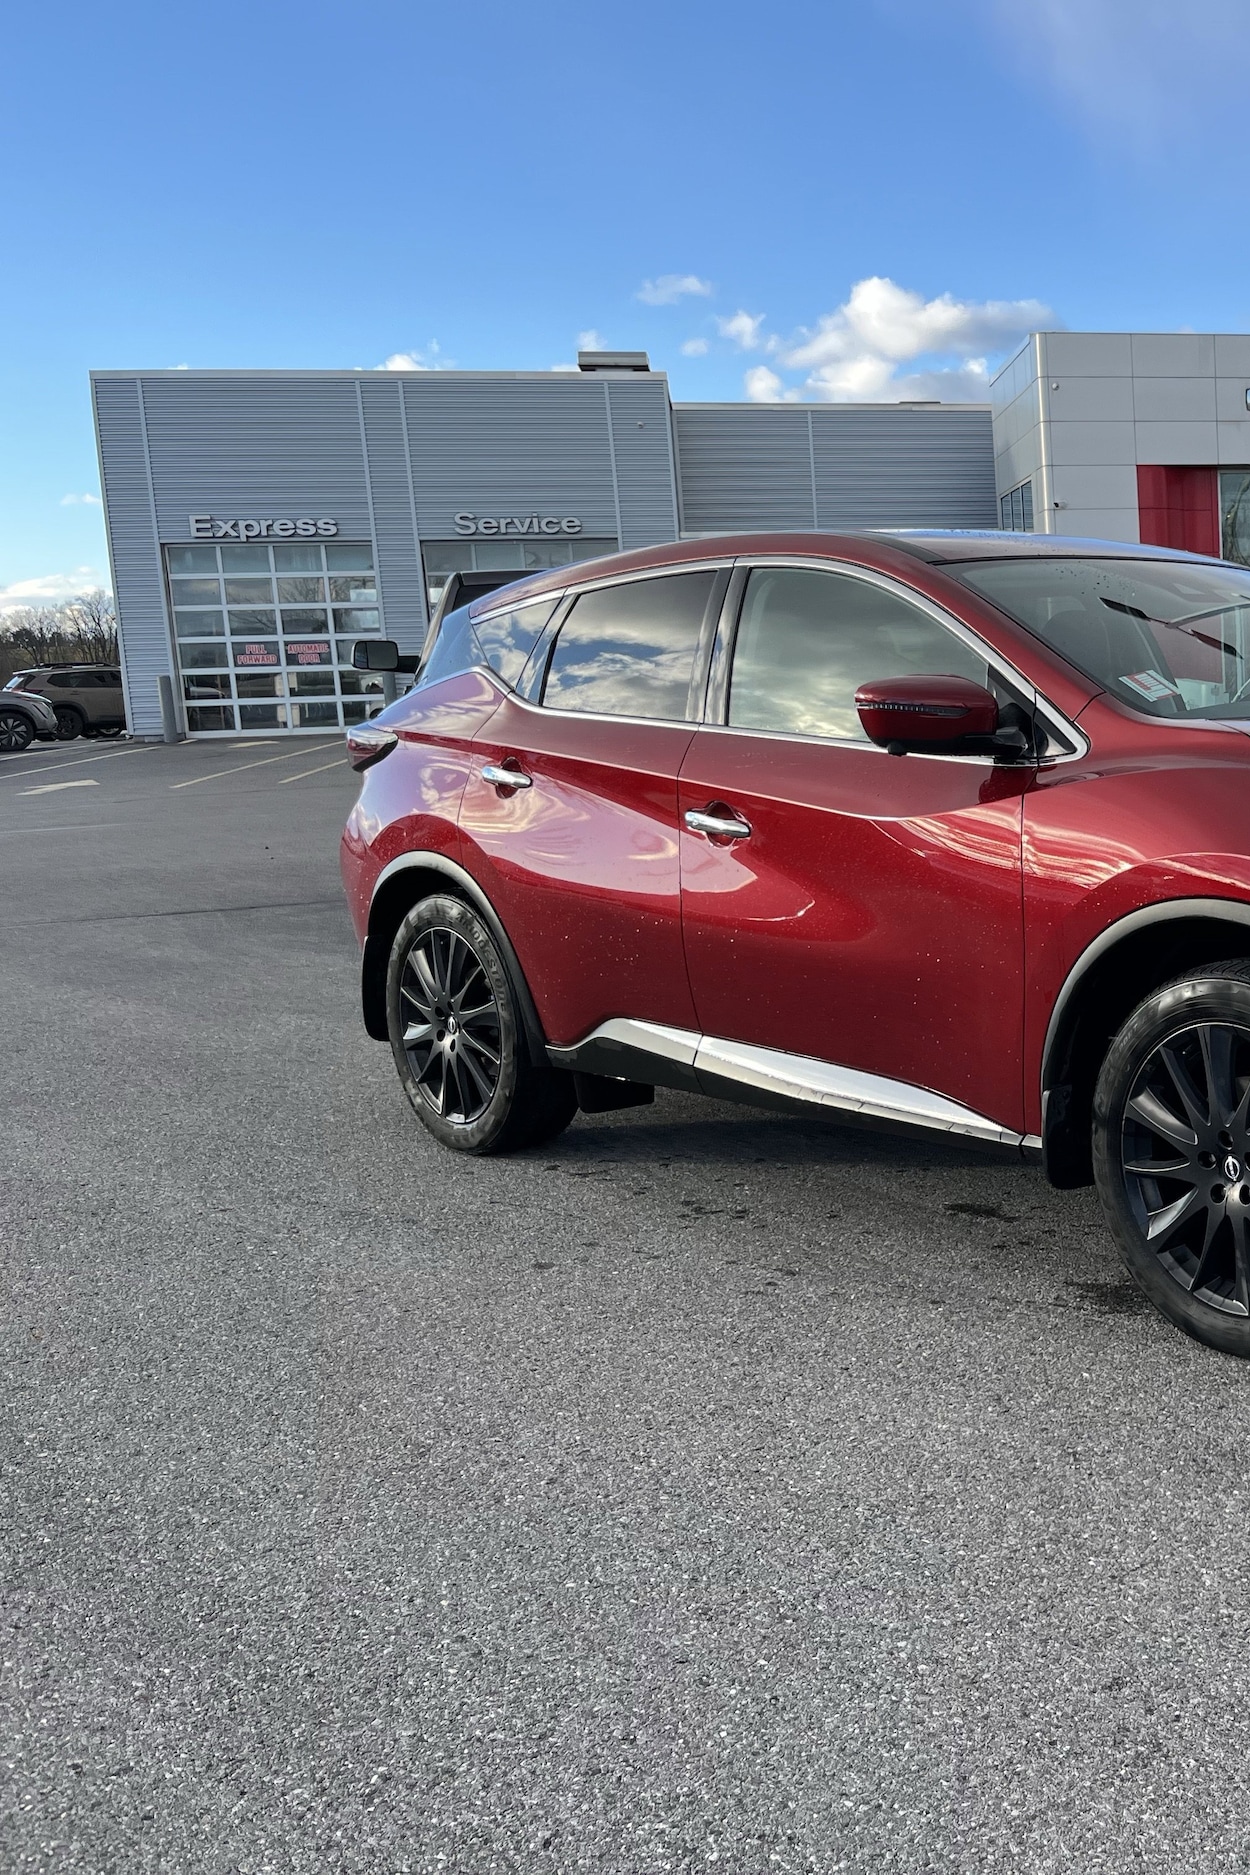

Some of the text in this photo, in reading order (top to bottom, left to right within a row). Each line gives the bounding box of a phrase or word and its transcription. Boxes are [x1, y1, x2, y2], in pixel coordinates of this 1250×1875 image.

[188, 514, 338, 542] Express
[454, 512, 582, 535] Service
[245, 644, 267, 654] PULL
[287, 643, 330, 654] AUTOMATIC
[237, 654, 277, 664] FORWARD
[298, 654, 320, 664] DOOR
